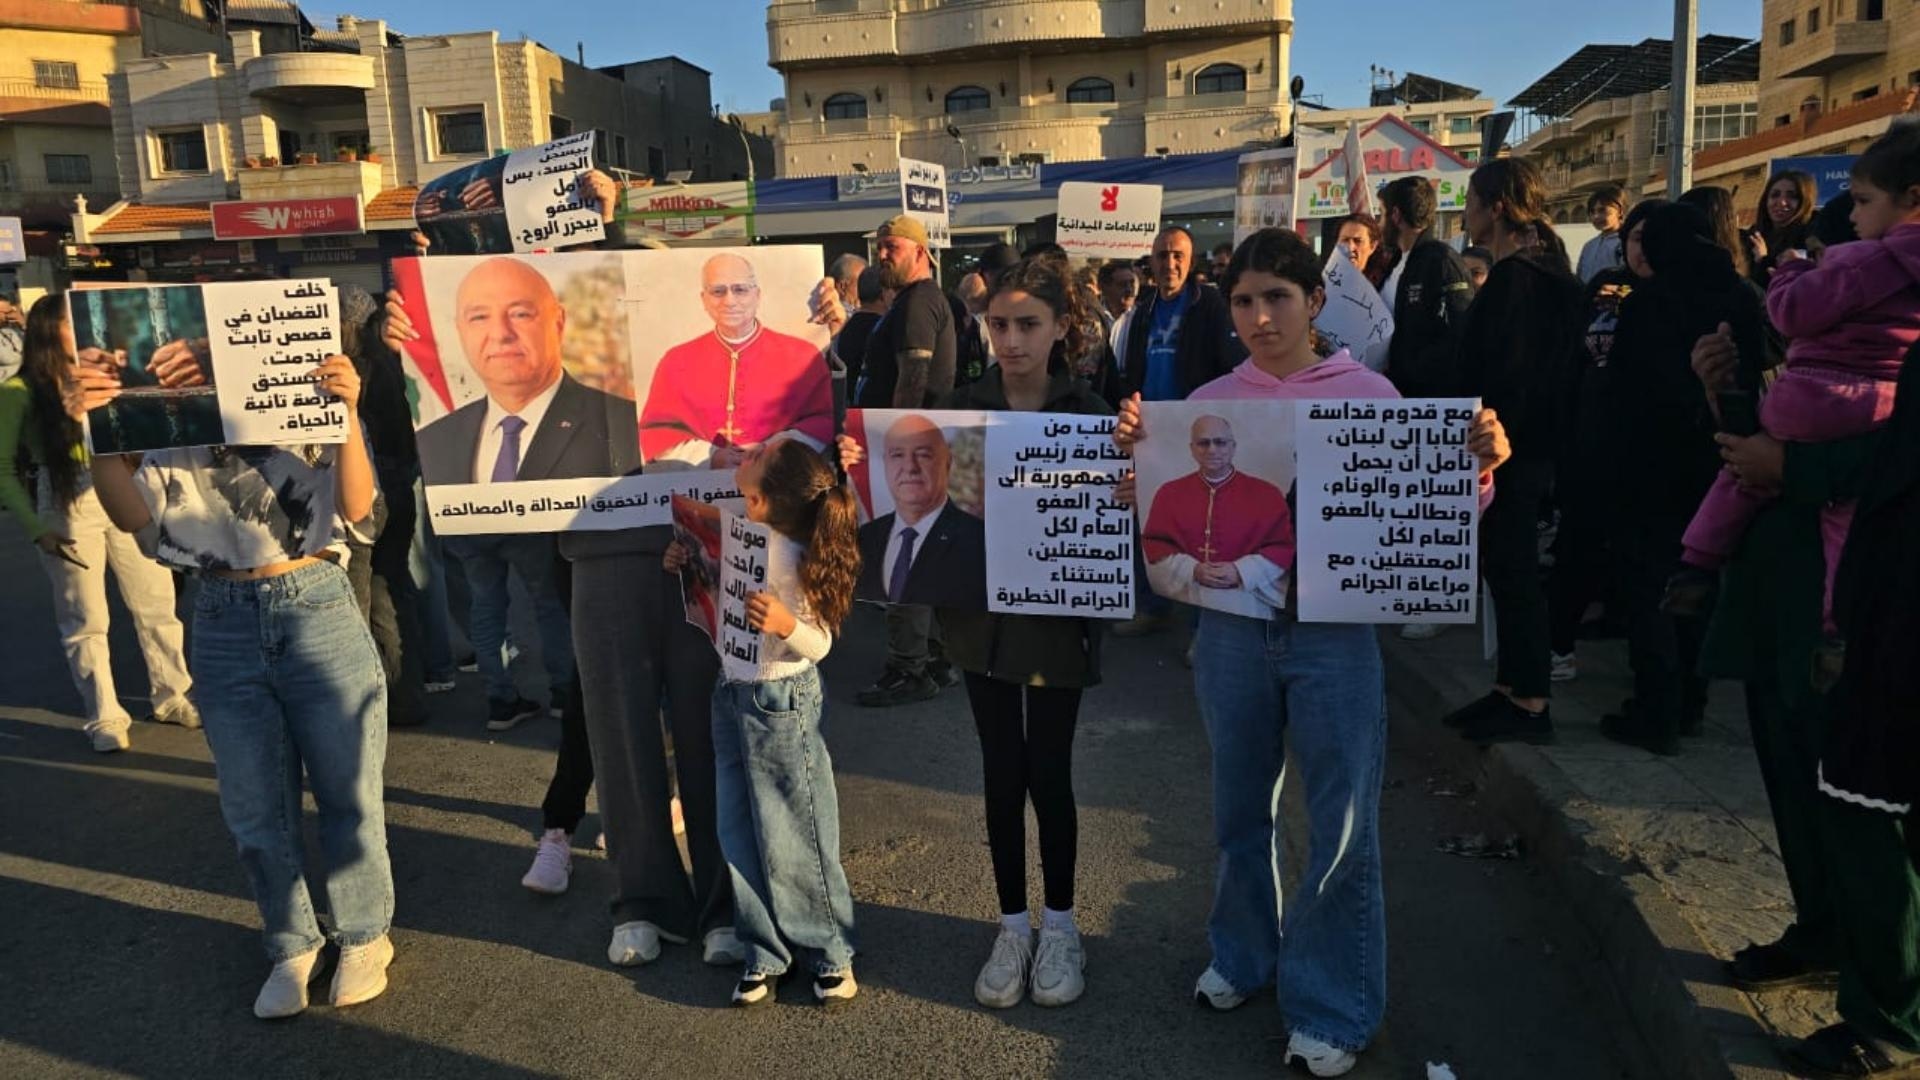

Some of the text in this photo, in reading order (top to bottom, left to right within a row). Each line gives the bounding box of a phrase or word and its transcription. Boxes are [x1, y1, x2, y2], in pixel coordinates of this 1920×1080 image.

[1364, 147, 1435, 172] ALA
[505, 171, 533, 184] بس
[1101, 186, 1119, 212] لا
[292, 205, 335, 219] whish
[1058, 216, 1102, 234] الميدانية
[284, 282, 326, 298] خلف
[225, 303, 328, 332] القضبان في
[228, 327, 332, 349] قصص تابت
[245, 393, 342, 414] فرصة تانية
[1309, 402, 1473, 426] مع قدوم قداسة
[280, 411, 343, 432] بالحياة.
[1044, 418, 1071, 438] من
[1328, 427, 1385, 449] لبنان،
[1390, 427, 1421, 449] إلى
[1016, 443, 1067, 464] رئيس
[1343, 448, 1472, 474] نأمل أن يحمل
[999, 466, 1025, 488] إلى
[1406, 479, 1472, 498] السلام
[435, 499, 526, 518] والمصالحة.
[530, 495, 587, 513] العدالة
[591, 491, 649, 513] لتحقيق
[1037, 492, 1089, 513] العفو
[1322, 500, 1471, 526] ونطالب بالعفو
[731, 515, 767, 549] صوتنا
[1045, 517, 1129, 537] العام لكل
[1379, 526, 1470, 547] العام لكل
[1028, 541, 1129, 561] المعتقلين،
[1328, 551, 1470, 571] المعتقلين، مع
[1050, 565, 1129, 589] باستثناء
[1340, 573, 1470, 595] مراعاة الجرائم
[997, 586, 1129, 611] الجرائم الخطيرة
